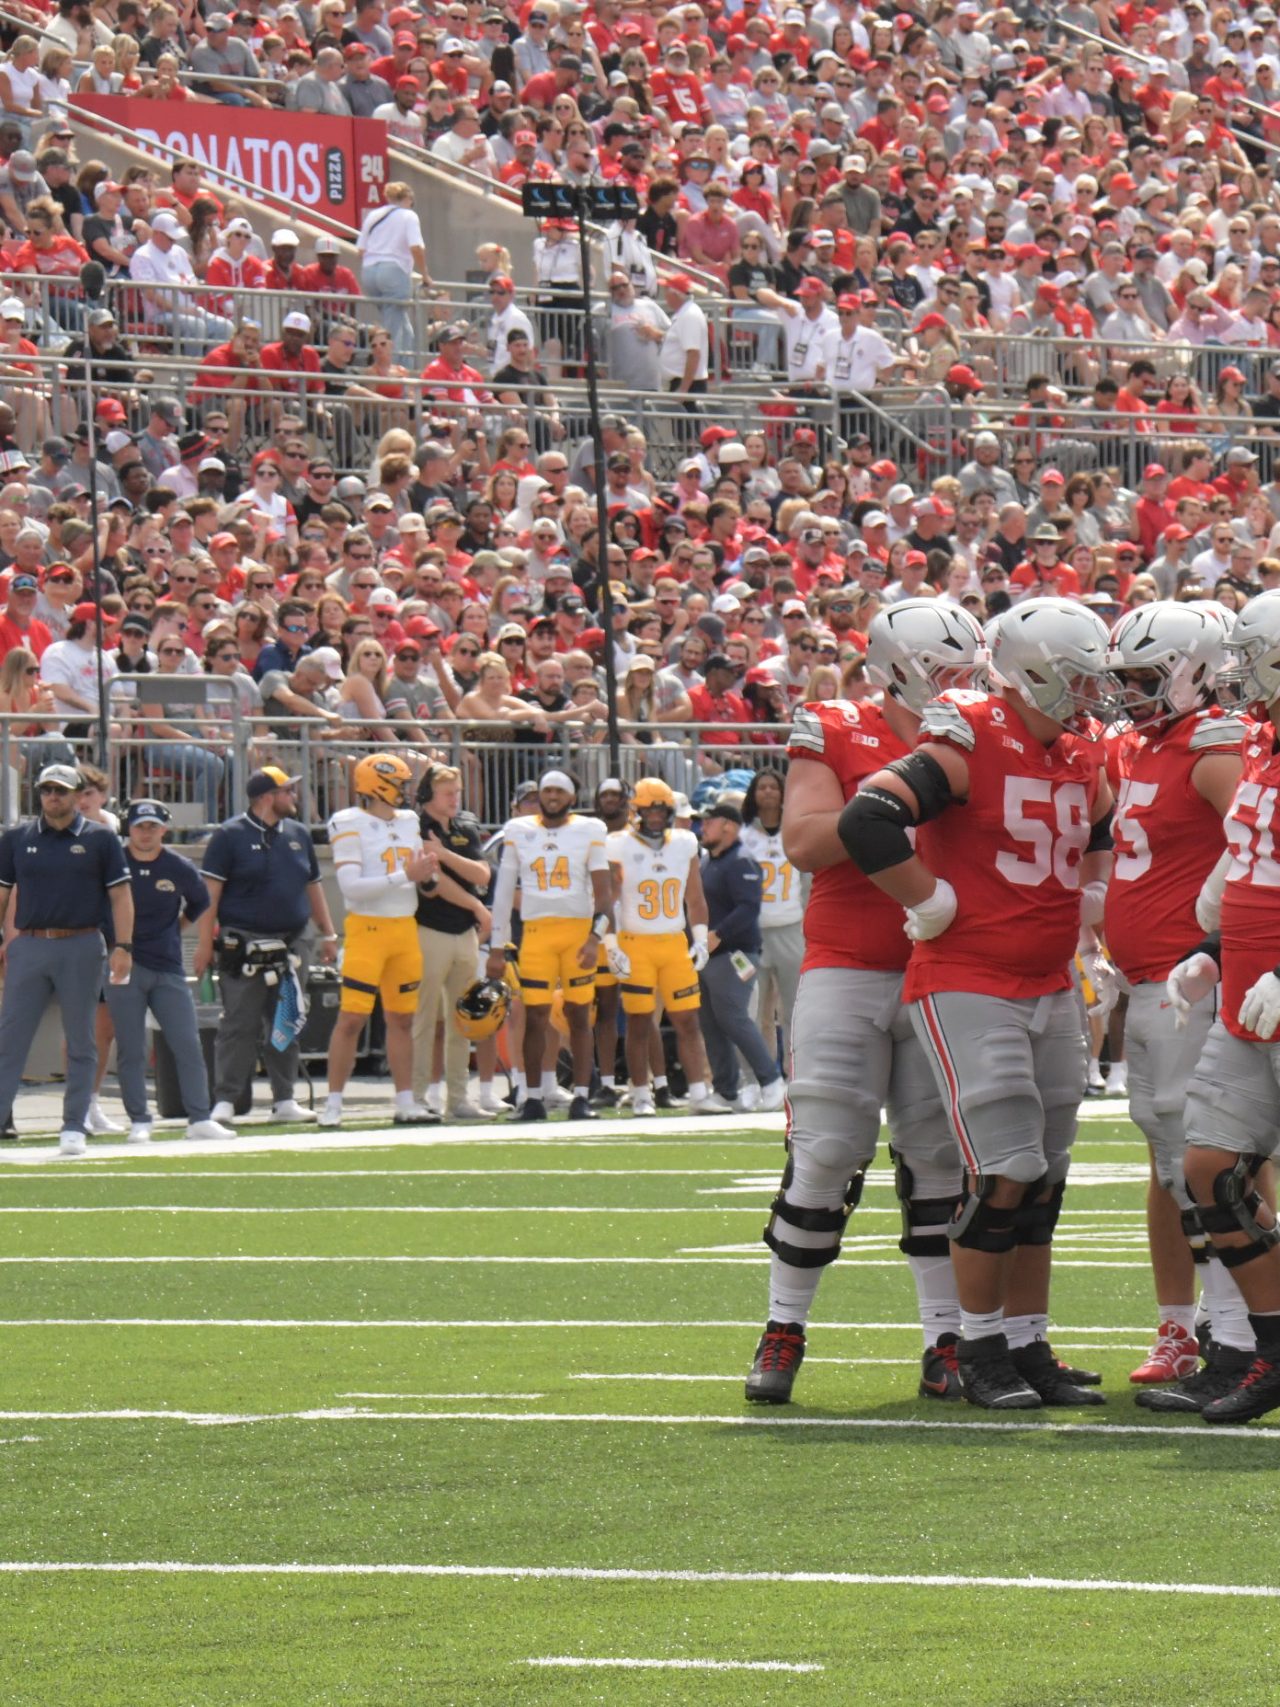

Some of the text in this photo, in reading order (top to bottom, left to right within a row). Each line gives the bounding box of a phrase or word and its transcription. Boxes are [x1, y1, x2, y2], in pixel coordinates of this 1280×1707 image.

[673, 88, 697, 114] 15
[330, 152, 342, 199] PIZZA
[361, 154, 384, 183] 24
[368, 185, 380, 203] A
[995, 775, 1092, 889] 58
[1110, 778, 1159, 881] 5
[530, 856, 571, 891] 14
[760, 861, 792, 902] 21
[637, 878, 682, 920] 30
